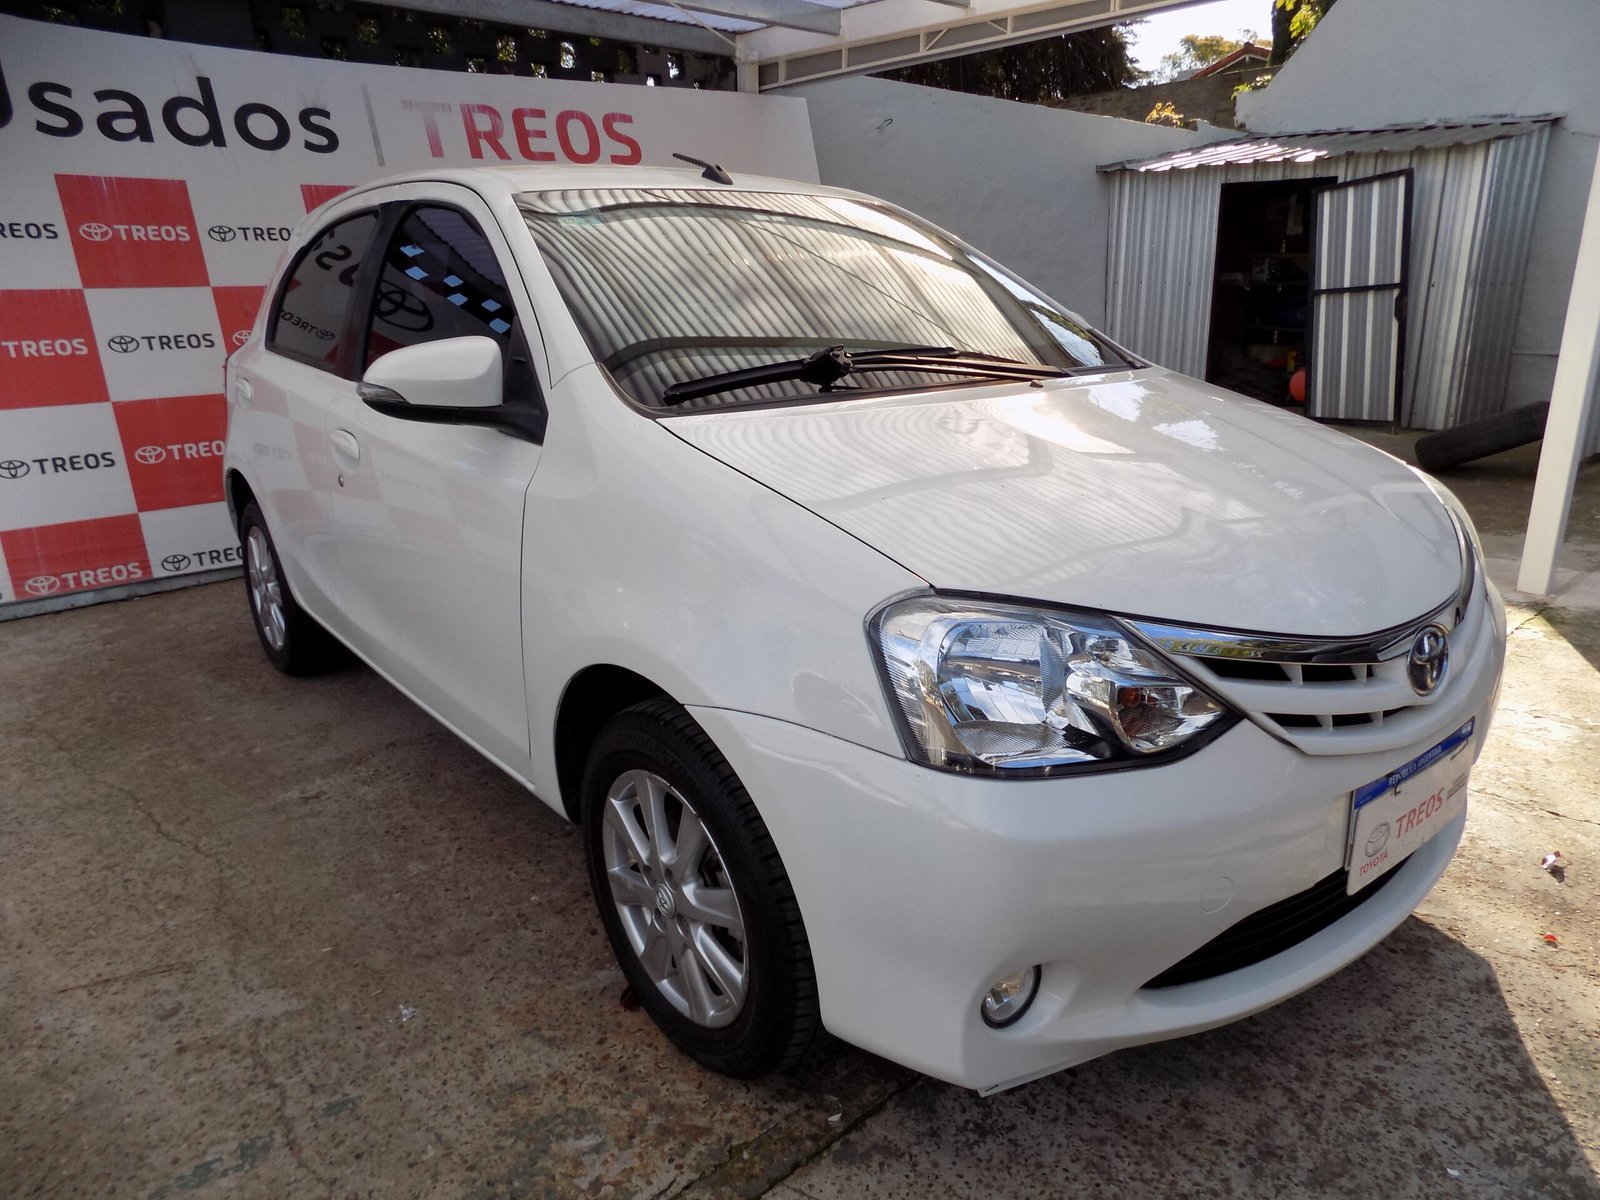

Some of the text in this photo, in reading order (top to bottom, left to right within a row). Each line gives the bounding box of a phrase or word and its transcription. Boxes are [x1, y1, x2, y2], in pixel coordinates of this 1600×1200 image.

[400, 99, 642, 165] TREOS
[112, 224, 190, 242] TREOS
[237, 227, 294, 242] TREO
[1, 338, 89, 358] TREOS
[141, 333, 215, 350] TREOS
[166, 440, 225, 460] TREO
[32, 452, 116, 475] TREOS
[61, 562, 143, 588] TREOS
[1395, 787, 1445, 839] TREOS
[1359, 851, 1388, 875] TOYOTA
